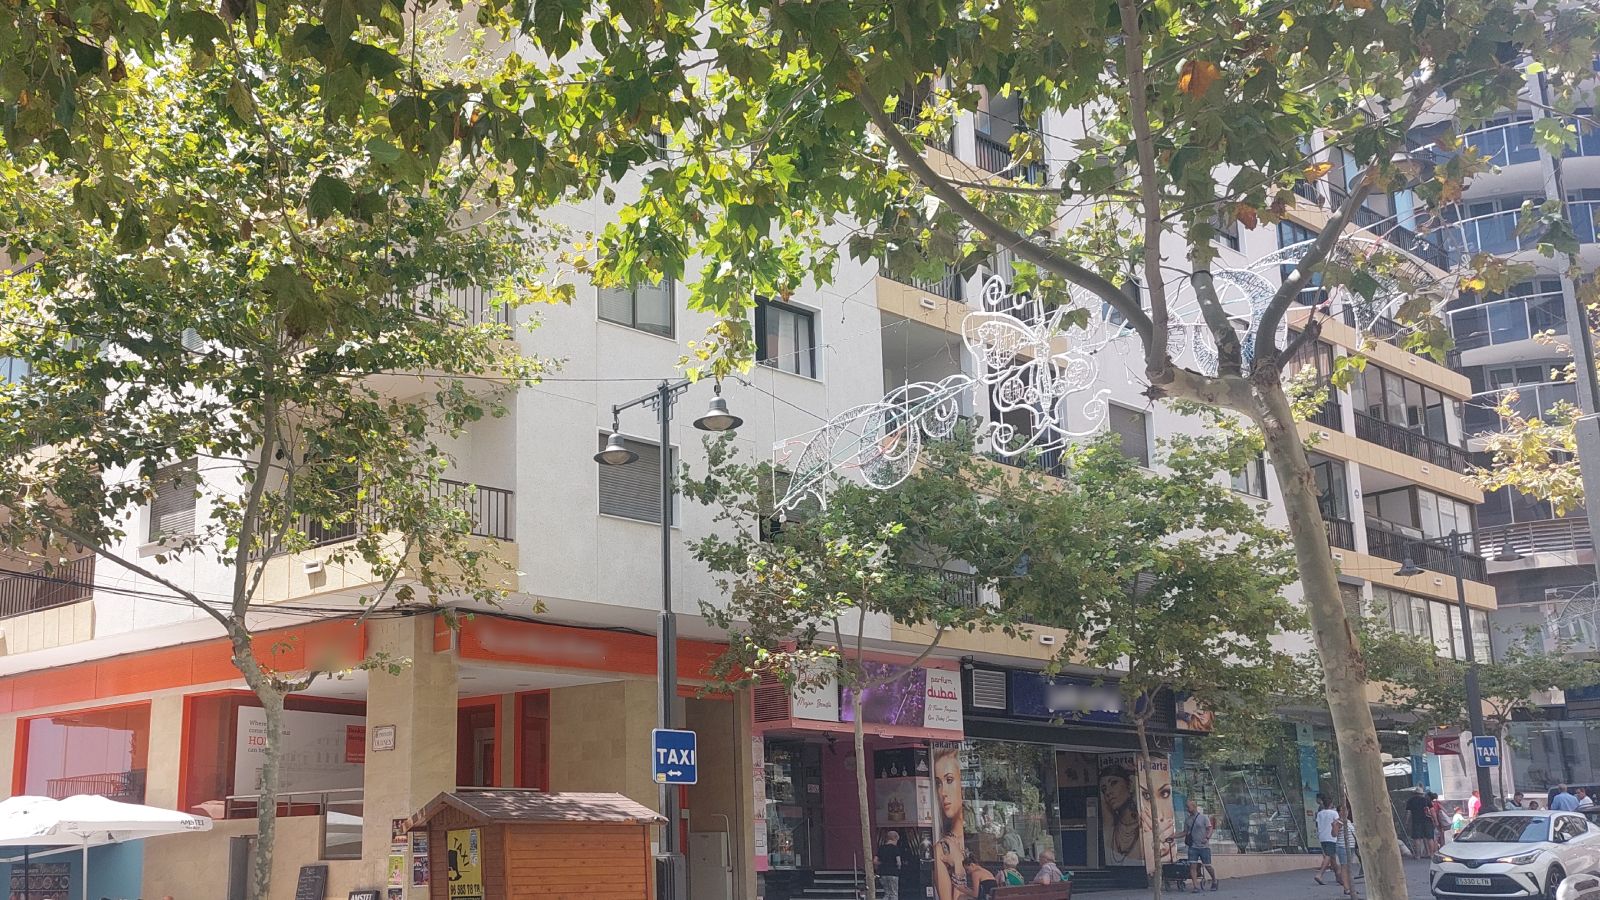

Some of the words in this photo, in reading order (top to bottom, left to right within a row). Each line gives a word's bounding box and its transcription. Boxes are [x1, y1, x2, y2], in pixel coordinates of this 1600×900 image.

[927, 686, 957, 700] dubai
[656, 748, 695, 765] TAXI
[1477, 747, 1497, 757] TAXI
[1100, 756, 1134, 769] jakarta
[454, 837, 470, 867] TAXI
